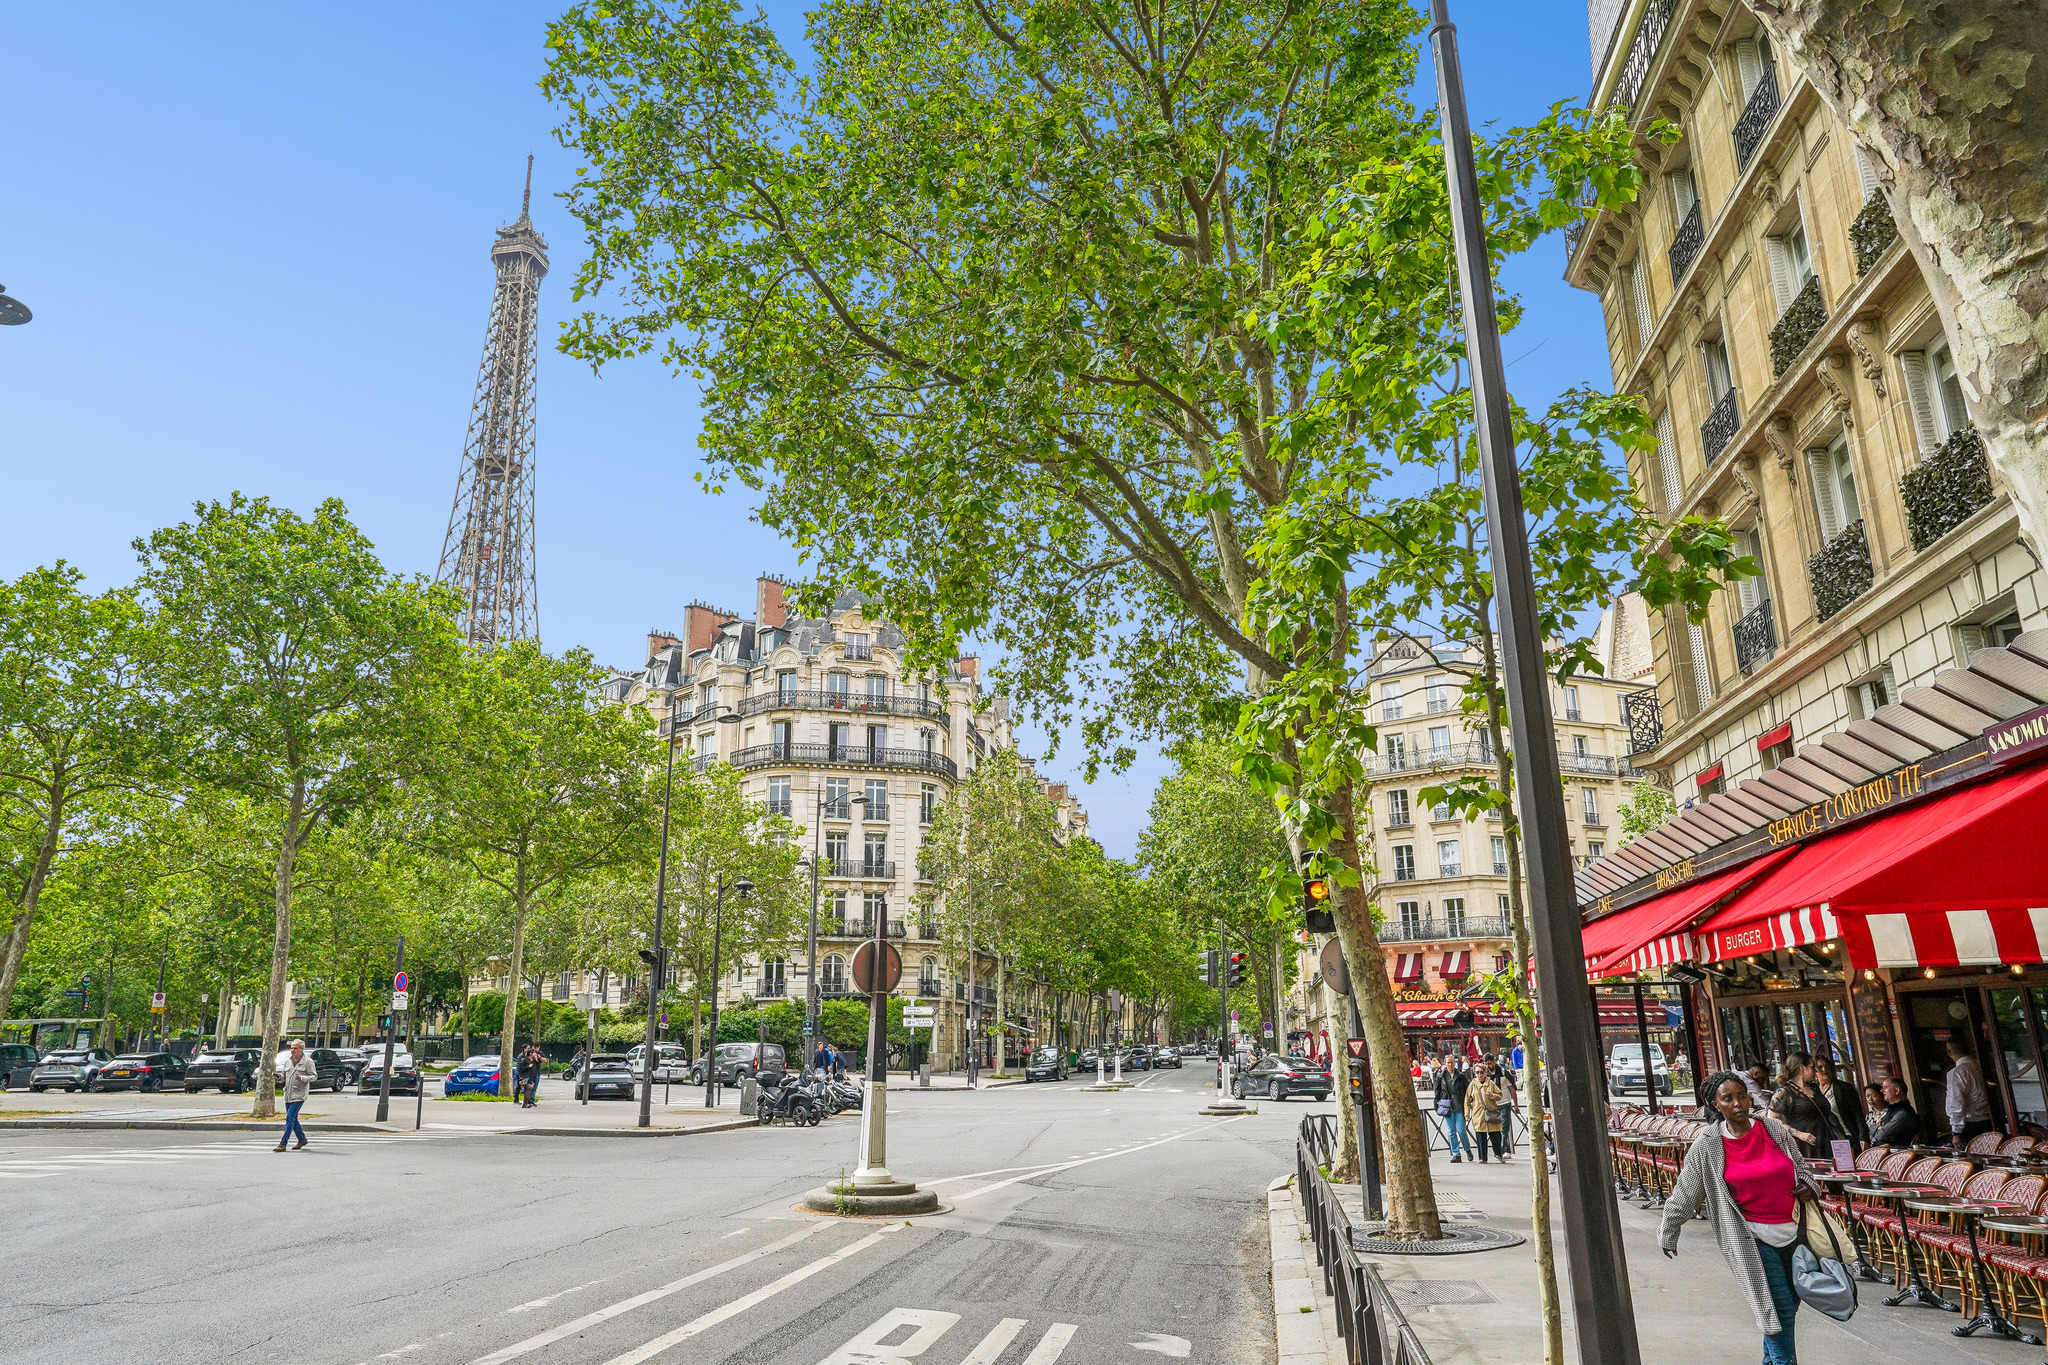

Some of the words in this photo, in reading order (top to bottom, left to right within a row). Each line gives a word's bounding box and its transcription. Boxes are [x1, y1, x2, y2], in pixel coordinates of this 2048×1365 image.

[1988, 713, 2048, 755] SANDWIC
[1768, 805, 1823, 846] SERVICE
[1825, 775, 1892, 824] CONTINU
[1655, 857, 1695, 890] BRASSERIE
[1725, 929, 1762, 951] BURGER
[1402, 990, 1444, 1002] Champ
